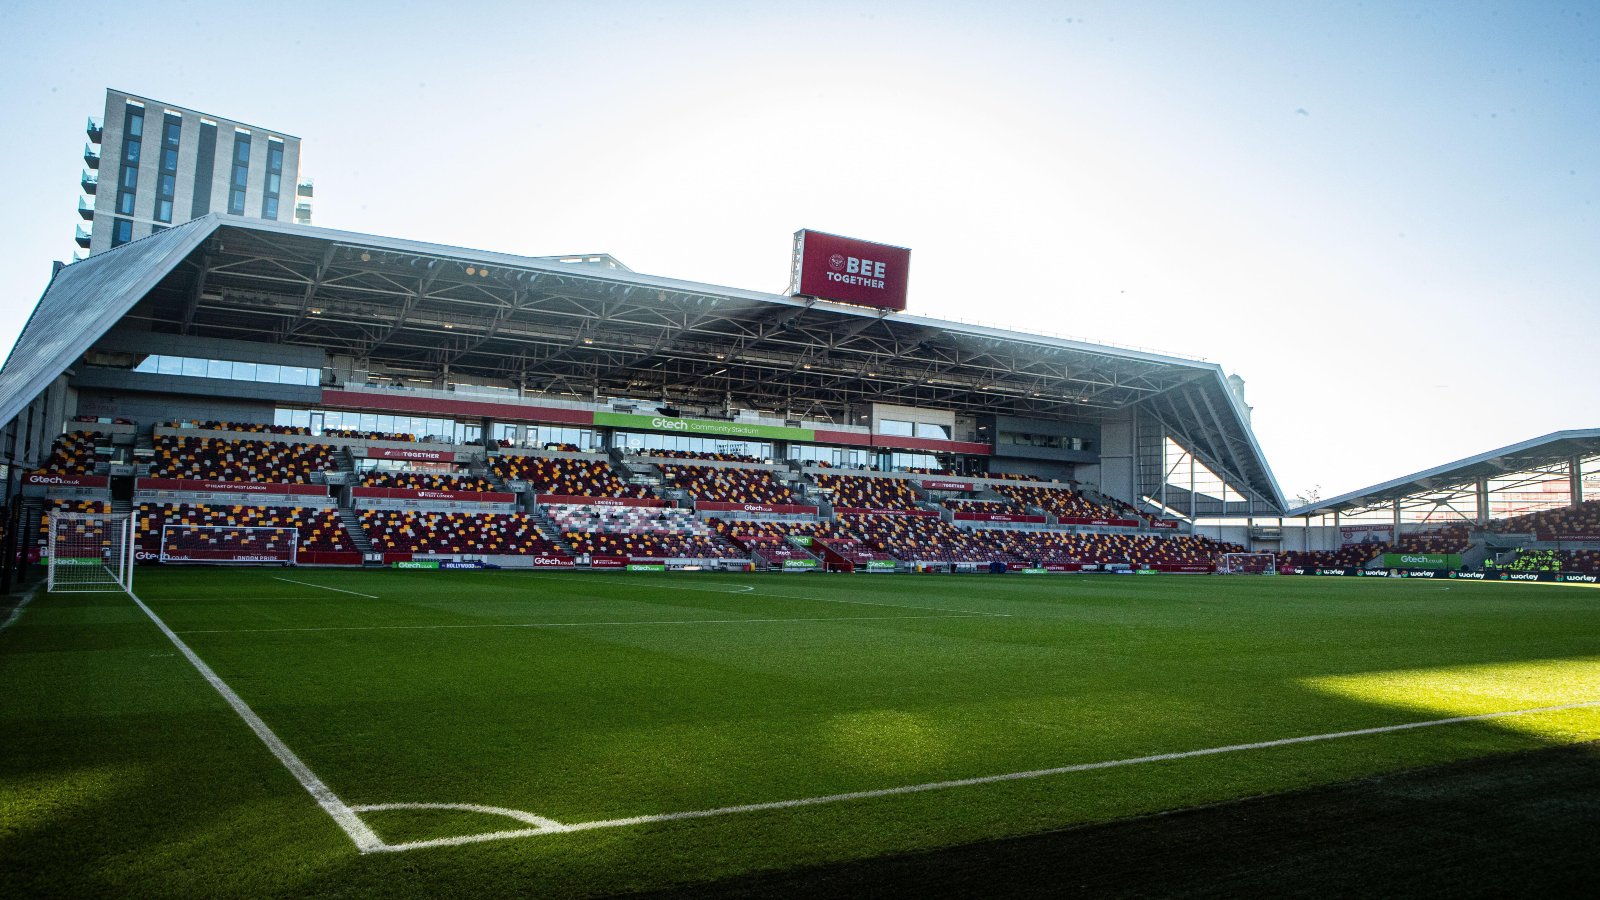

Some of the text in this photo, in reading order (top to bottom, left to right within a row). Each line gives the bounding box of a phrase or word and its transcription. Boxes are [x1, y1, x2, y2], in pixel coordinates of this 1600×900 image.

[847, 257, 886, 278] BEE
[827, 272, 885, 289] TOGETHER
[652, 418, 759, 434] Gtech Community Stadium
[30, 475, 80, 485] Gtech.co.uk
[534, 557, 574, 565] Gtech.co.uk
[1365, 569, 1388, 577] worley
[1409, 570, 1434, 578] worley
[1458, 571, 1485, 579] worley
[1510, 572, 1538, 580] worley
[1566, 574, 1596, 582] worley
